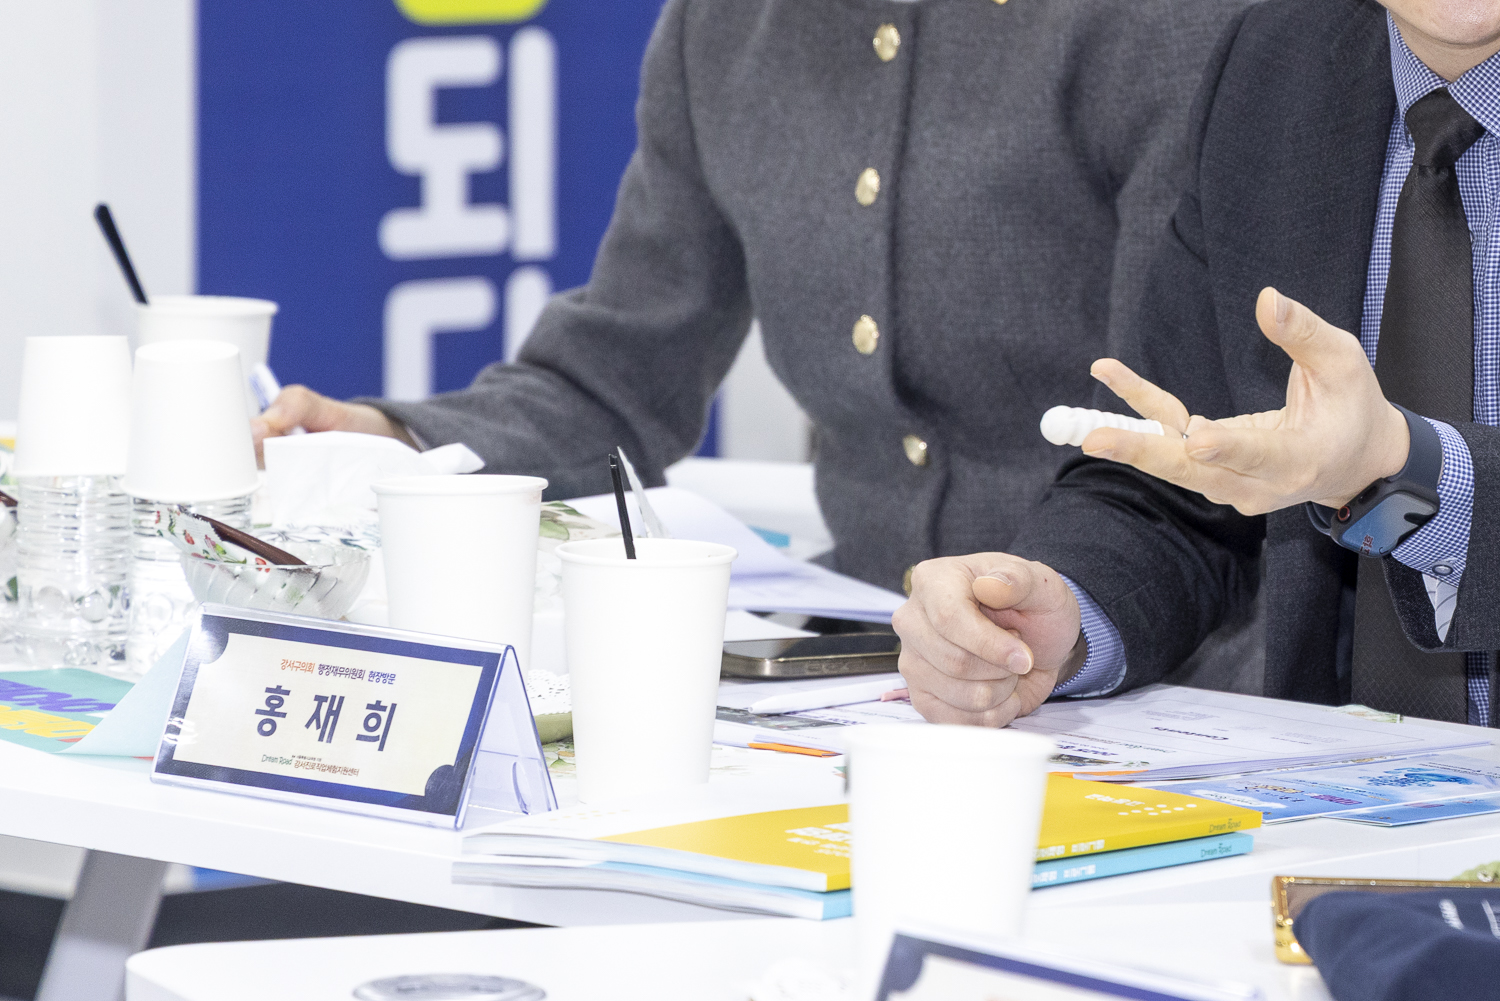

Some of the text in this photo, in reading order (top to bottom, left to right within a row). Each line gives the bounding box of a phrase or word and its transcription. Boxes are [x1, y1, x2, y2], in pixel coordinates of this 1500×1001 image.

[280, 658, 397, 685] 강서구의회 행정재무위원회 현장방문
